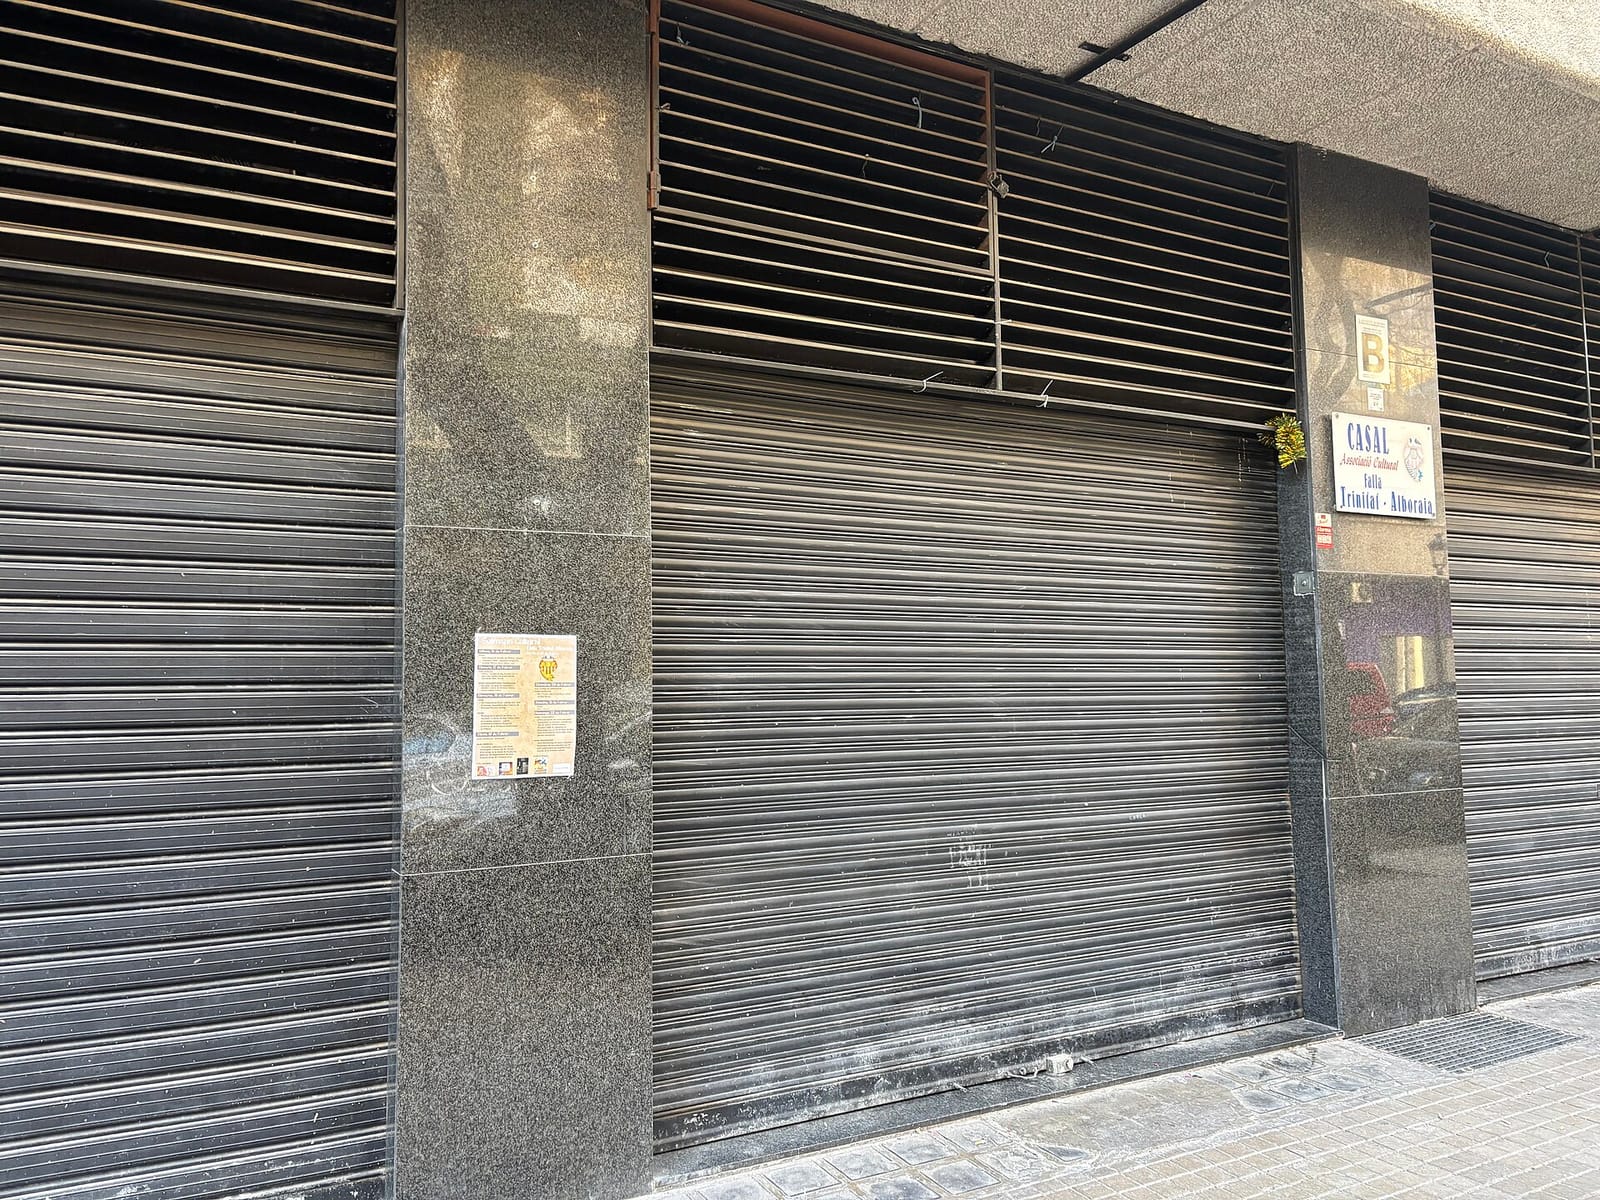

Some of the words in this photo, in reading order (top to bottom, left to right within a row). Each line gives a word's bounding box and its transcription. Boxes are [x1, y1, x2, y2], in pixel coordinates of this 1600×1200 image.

[1361, 332, 1384, 373] B
[1347, 422, 1389, 455] CASAL
[1373, 456, 1399, 471] Cultural
[1364, 473, 1382, 489] Falla
[1391, 491, 1433, 514] Alboraia
